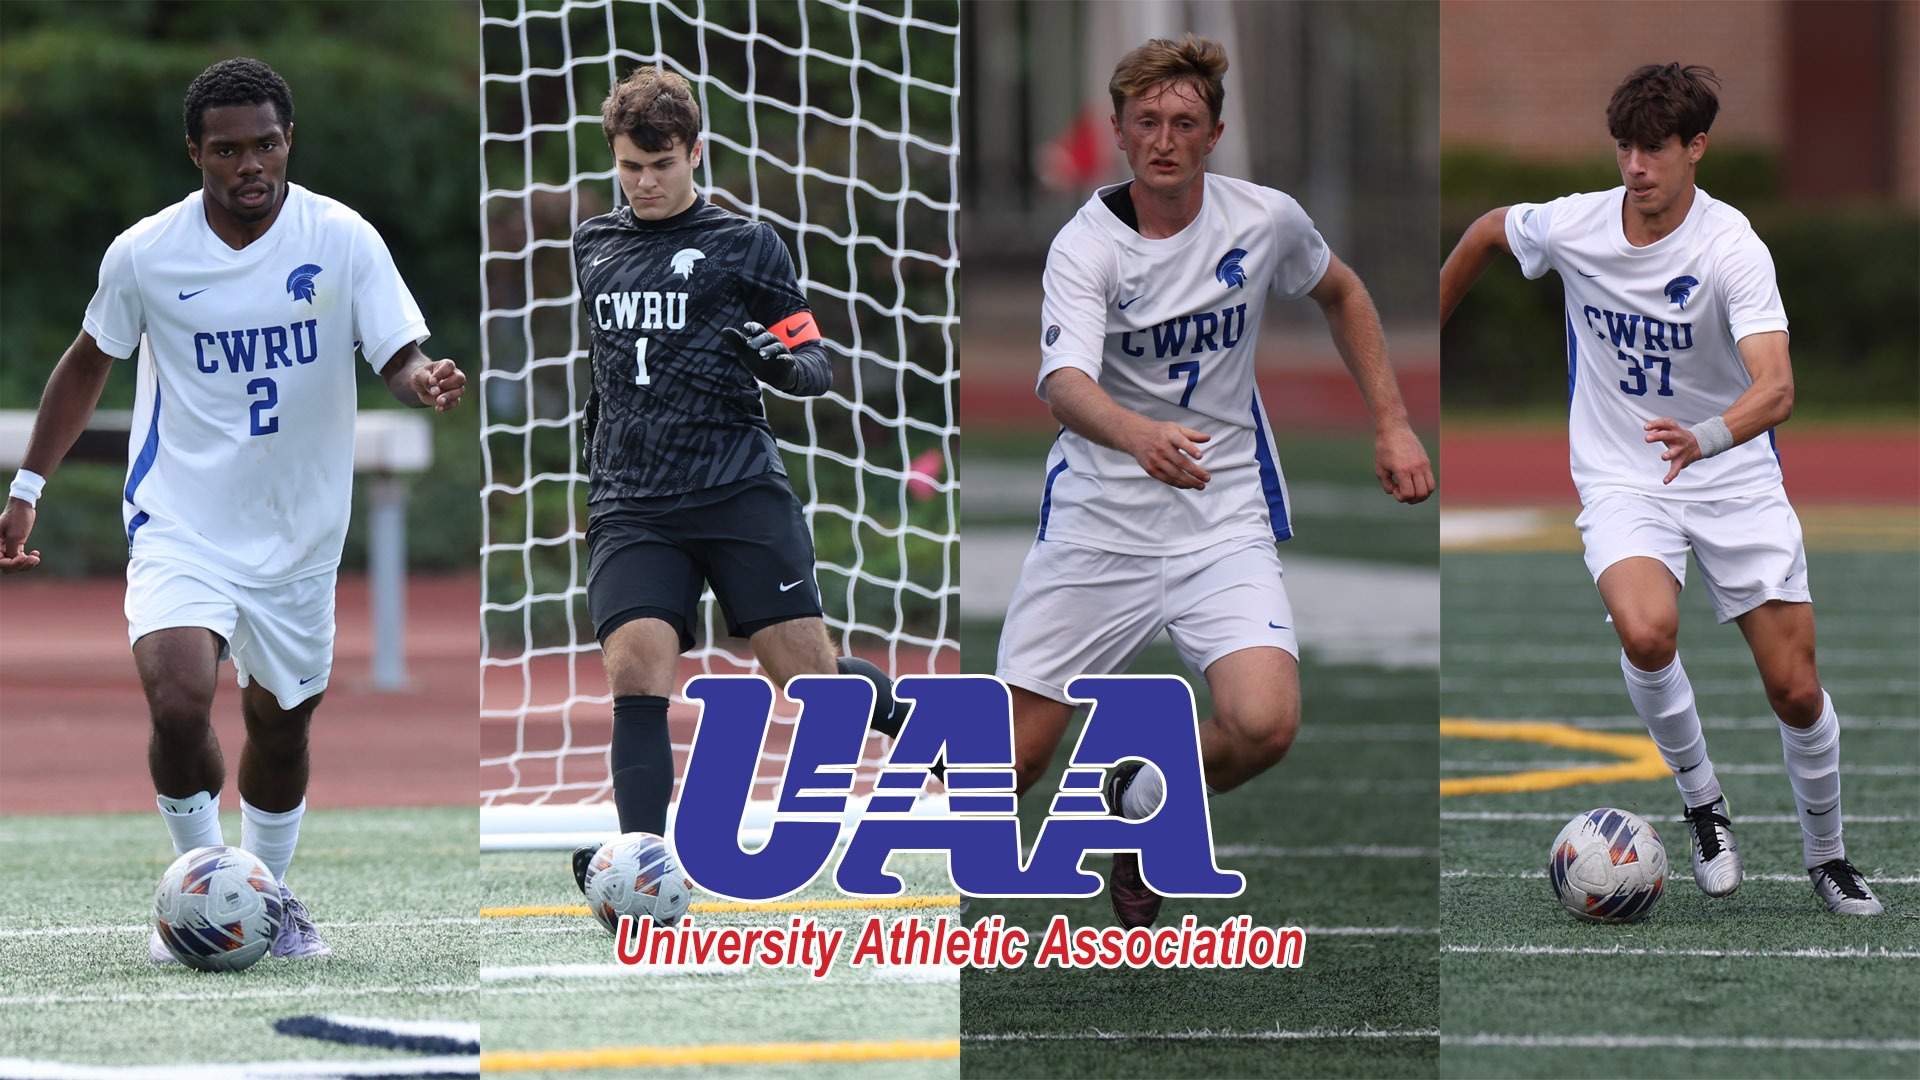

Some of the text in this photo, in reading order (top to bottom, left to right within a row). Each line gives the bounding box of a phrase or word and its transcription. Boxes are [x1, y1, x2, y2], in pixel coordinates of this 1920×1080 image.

[594, 291, 689, 331] CWRU
[1121, 302, 1247, 358] CWRU
[1584, 304, 1694, 352] CWRU
[194, 319, 318, 374] CWRU
[634, 337, 651, 385] 1
[1168, 360, 1200, 408] 7
[1617, 351, 1674, 397] 37
[246, 377, 279, 436] 2
